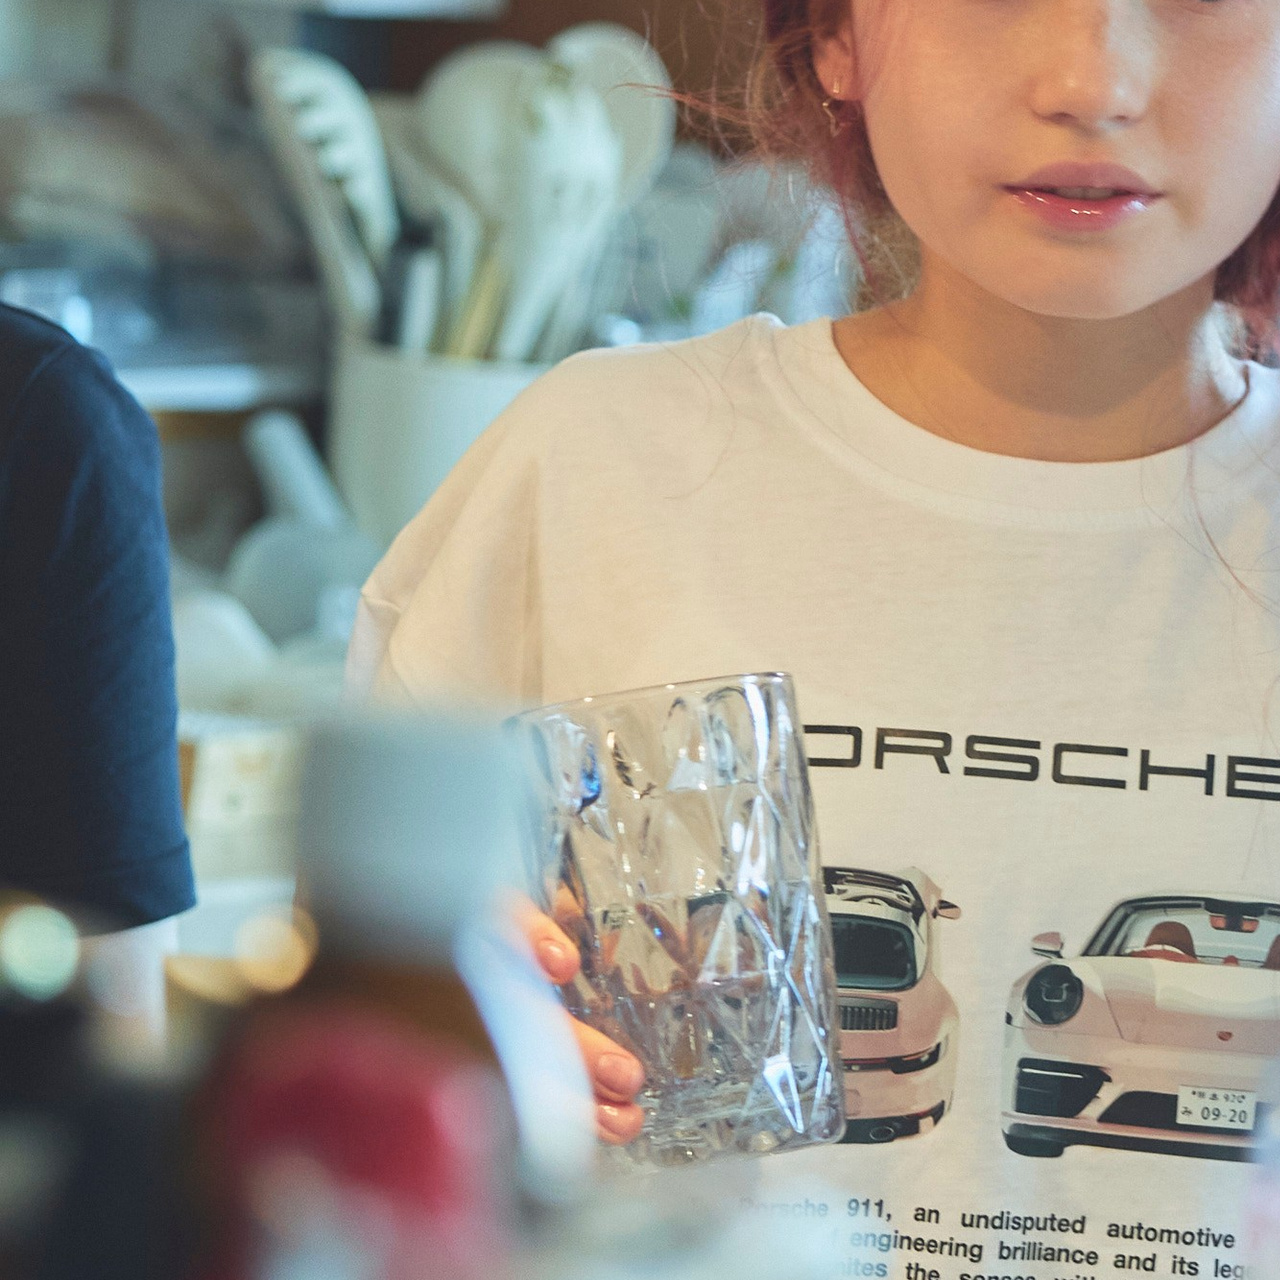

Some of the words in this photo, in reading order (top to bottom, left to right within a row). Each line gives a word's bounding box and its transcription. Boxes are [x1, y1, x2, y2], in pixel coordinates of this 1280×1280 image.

[847, 1198, 892, 1221] 911,
[914, 1206, 940, 1224] an
[961, 1210, 1086, 1237] undisputed
[1107, 1220, 1236, 1249] automotive
[850, 1231, 984, 1262] engineering
[999, 1241, 1099, 1265] brilliance
[1114, 1253, 1157, 1273] and
[1172, 1255, 1200, 1277] its
